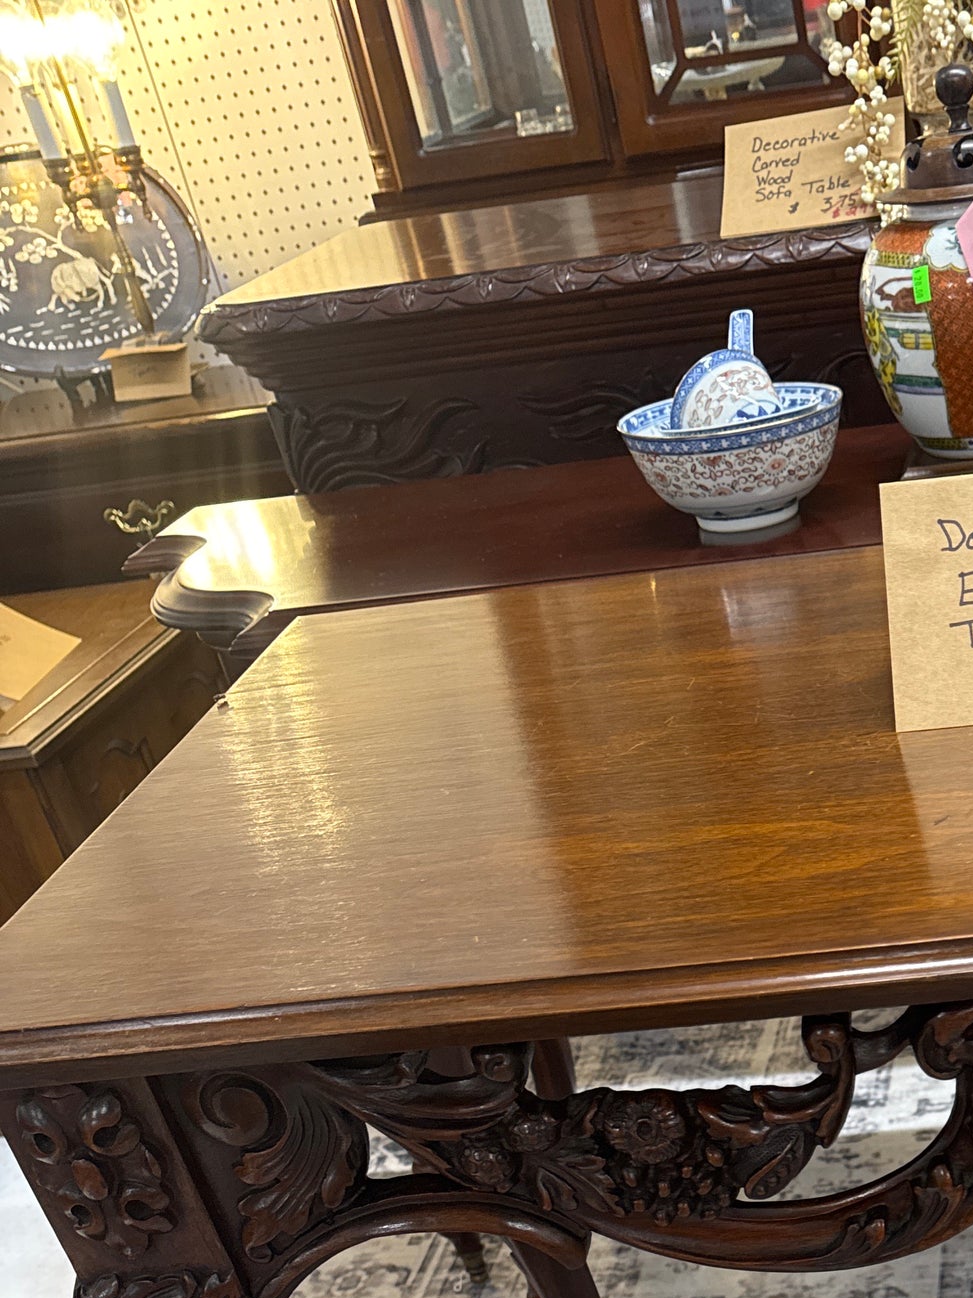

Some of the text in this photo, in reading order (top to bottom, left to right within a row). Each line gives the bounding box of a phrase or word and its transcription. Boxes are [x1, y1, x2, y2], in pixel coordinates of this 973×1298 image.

[751, 128, 840, 153] Decorative
[751, 151, 801, 173] Carved
[755, 175, 851, 203] Sofa Table
[756, 169, 794, 187] Wood
